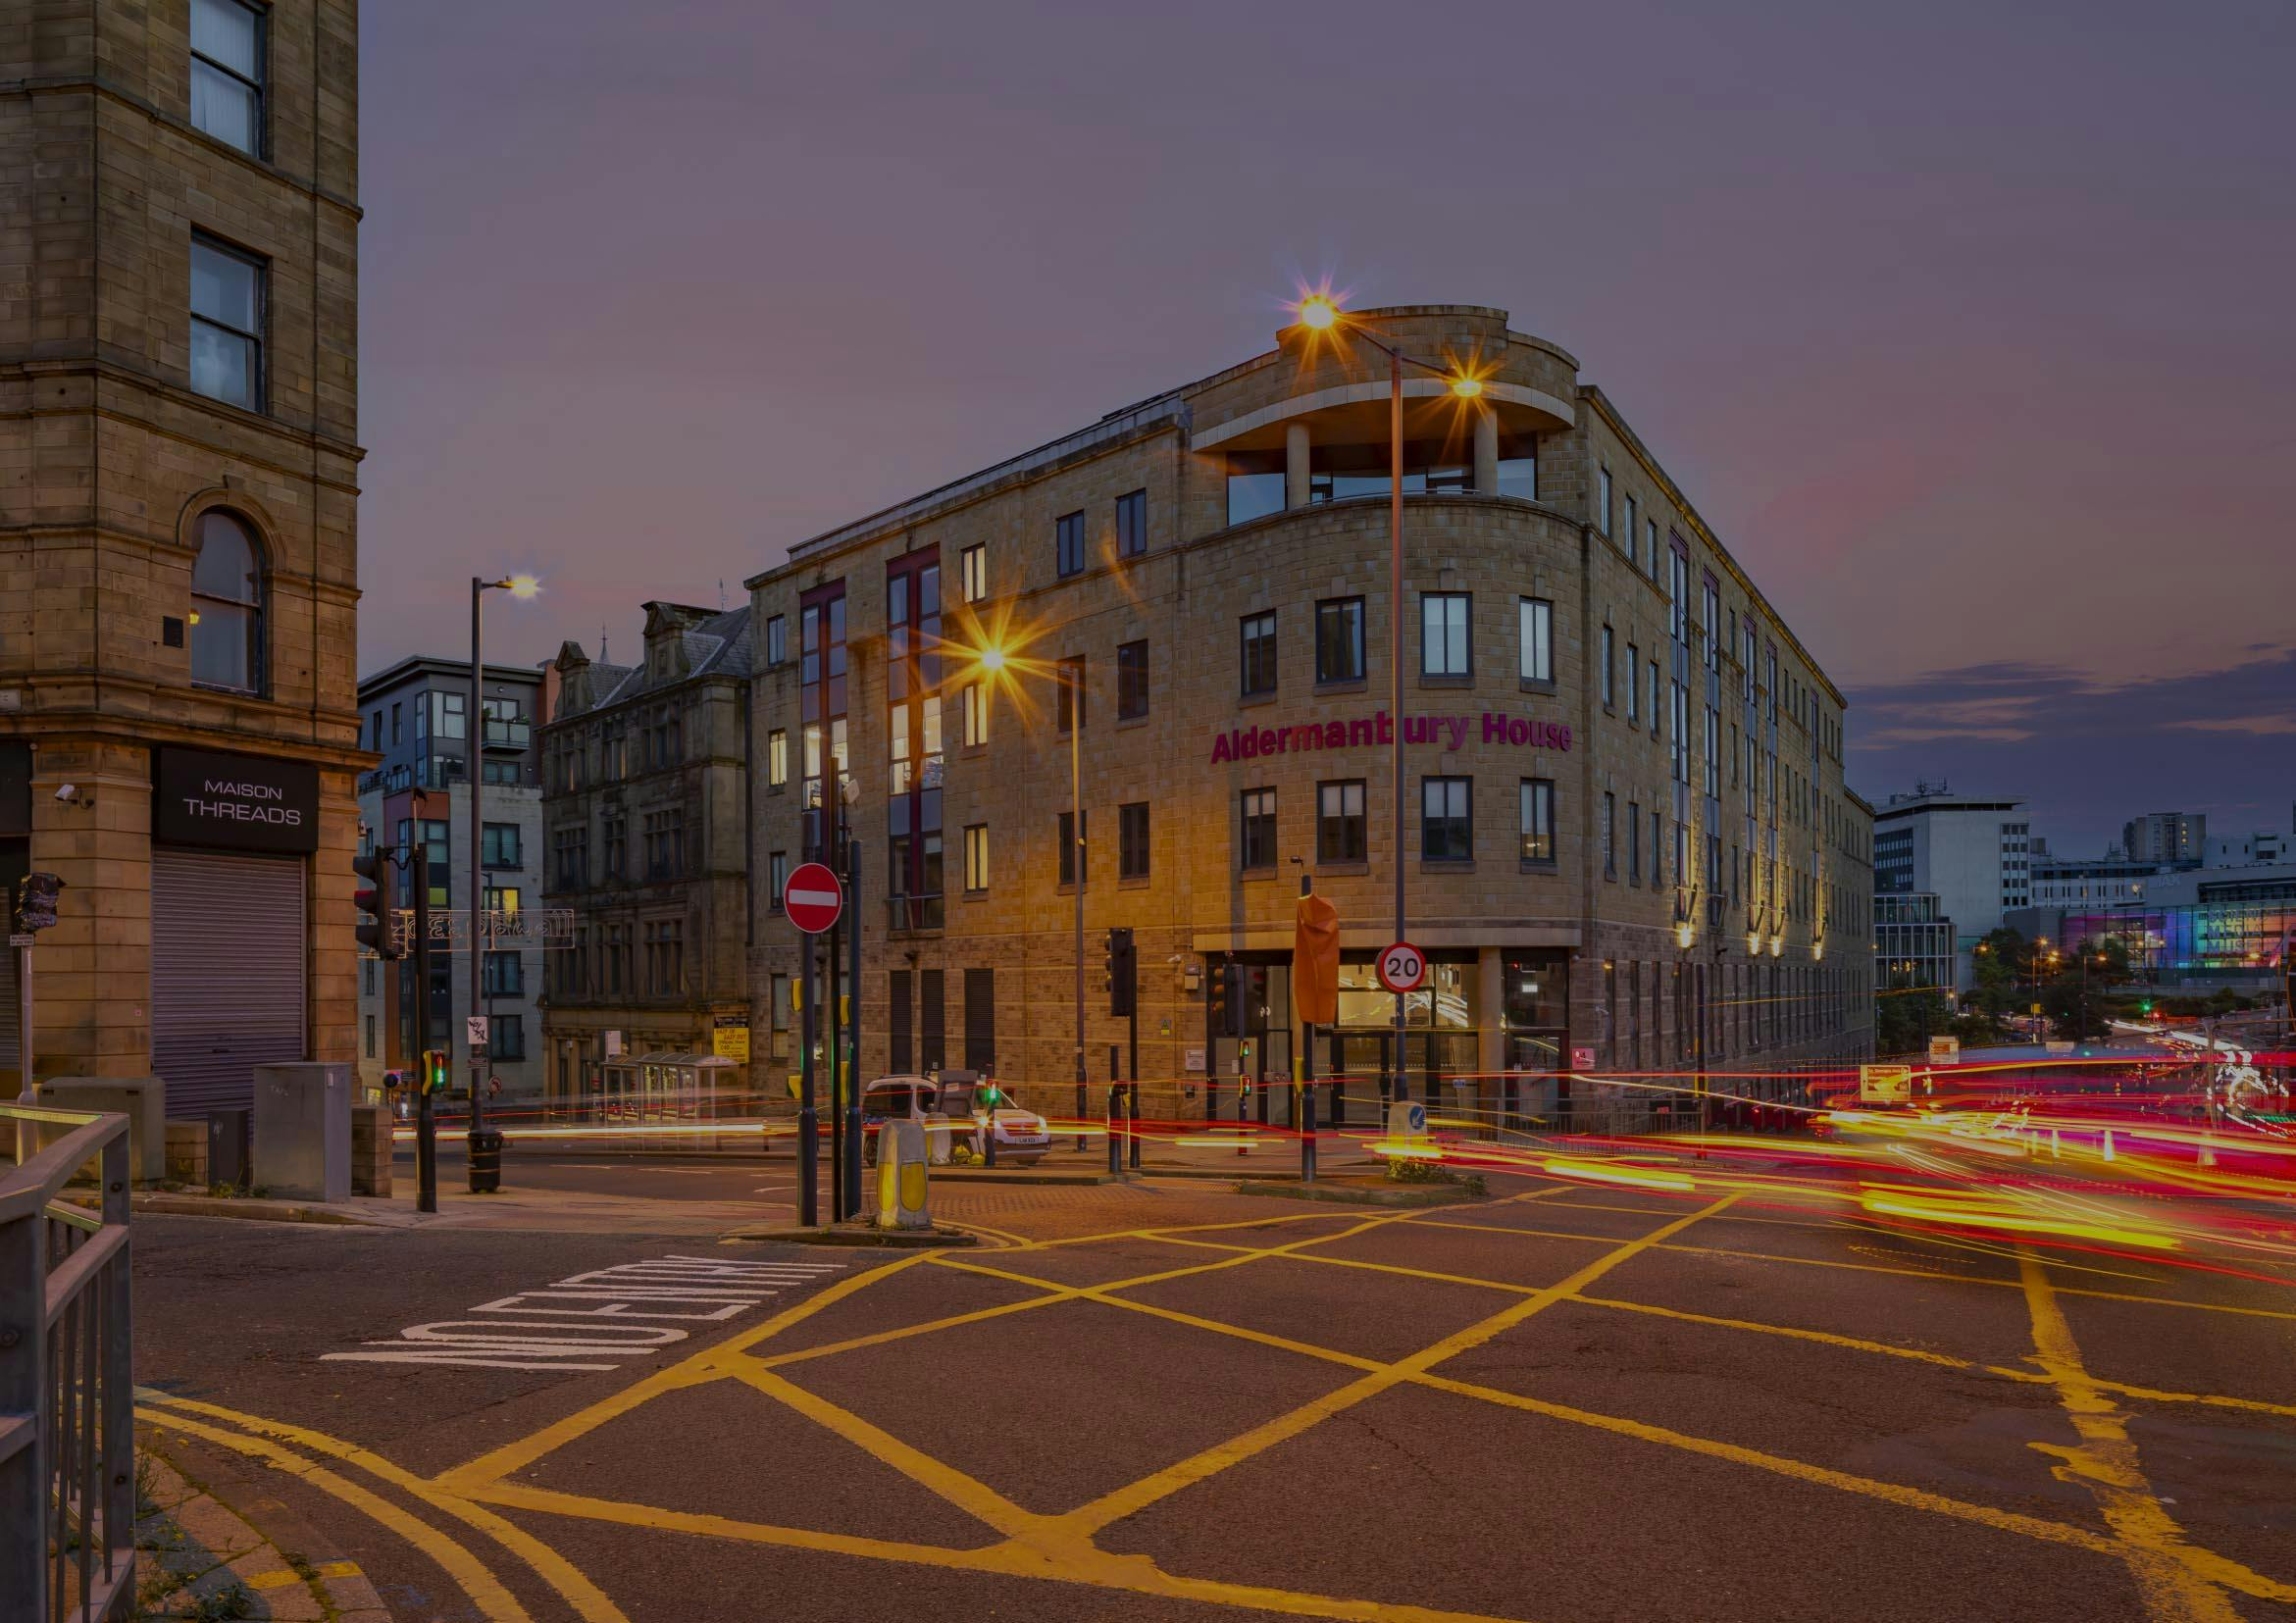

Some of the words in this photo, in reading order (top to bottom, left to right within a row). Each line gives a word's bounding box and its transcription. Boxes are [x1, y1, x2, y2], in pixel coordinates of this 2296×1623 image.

[1210, 711, 1469, 764] Aldermanbury
[1482, 712, 1573, 752] House
[204, 779, 282, 800] MAISON
[182, 798, 301, 825] THREADS
[1388, 957, 1419, 978] 20
[467, 1254, 848, 1321] ENTRY
[319, 1320, 689, 1371] NO
